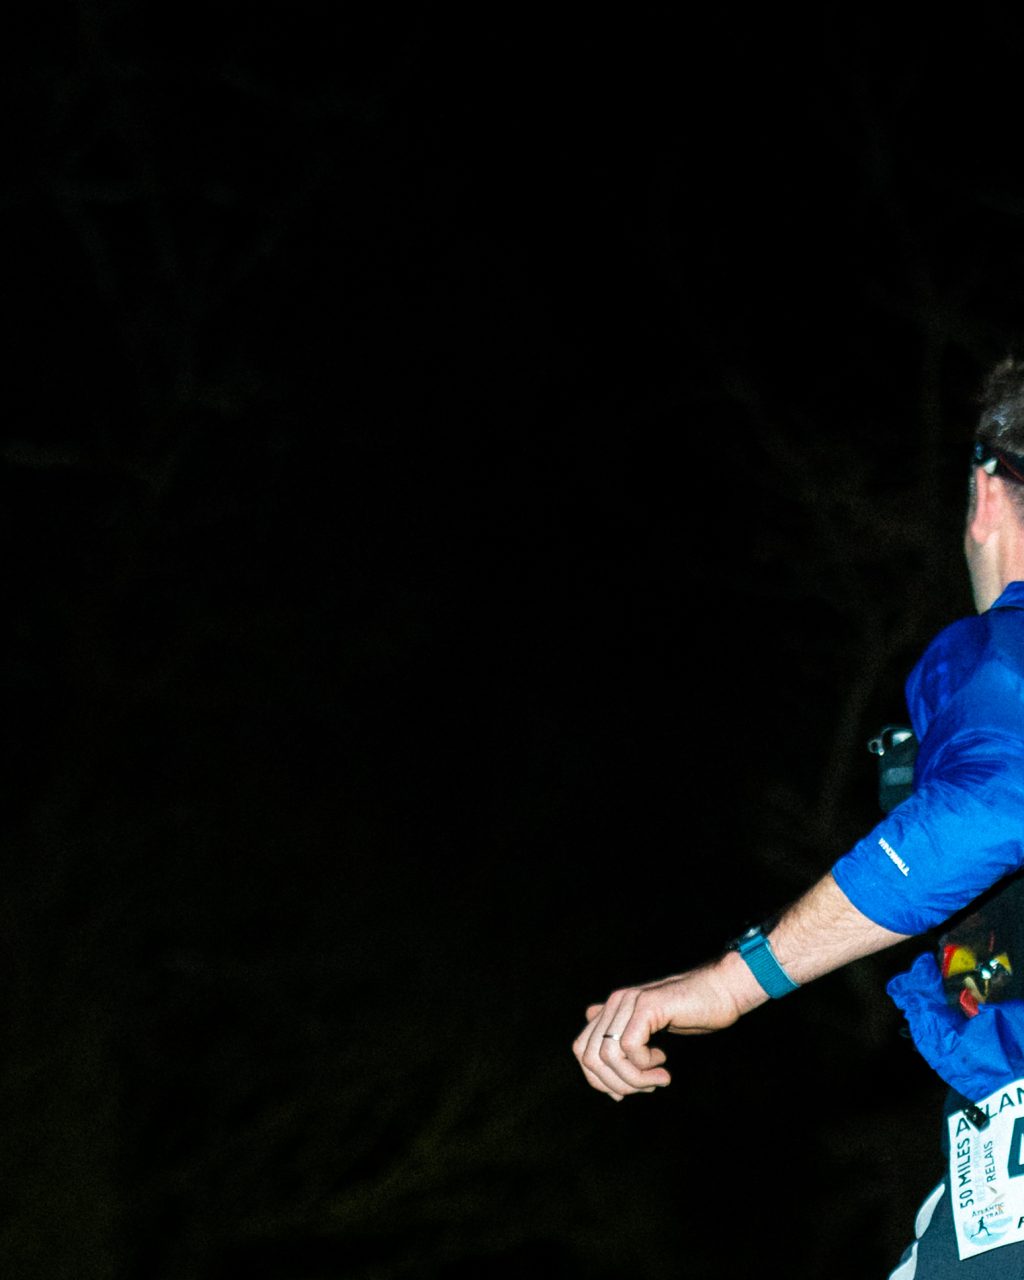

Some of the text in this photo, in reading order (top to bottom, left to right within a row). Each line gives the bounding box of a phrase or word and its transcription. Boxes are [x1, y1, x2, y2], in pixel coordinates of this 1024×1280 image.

[957, 1138, 974, 1209] 50 MILES
[983, 1140, 996, 1183] RELAIS
